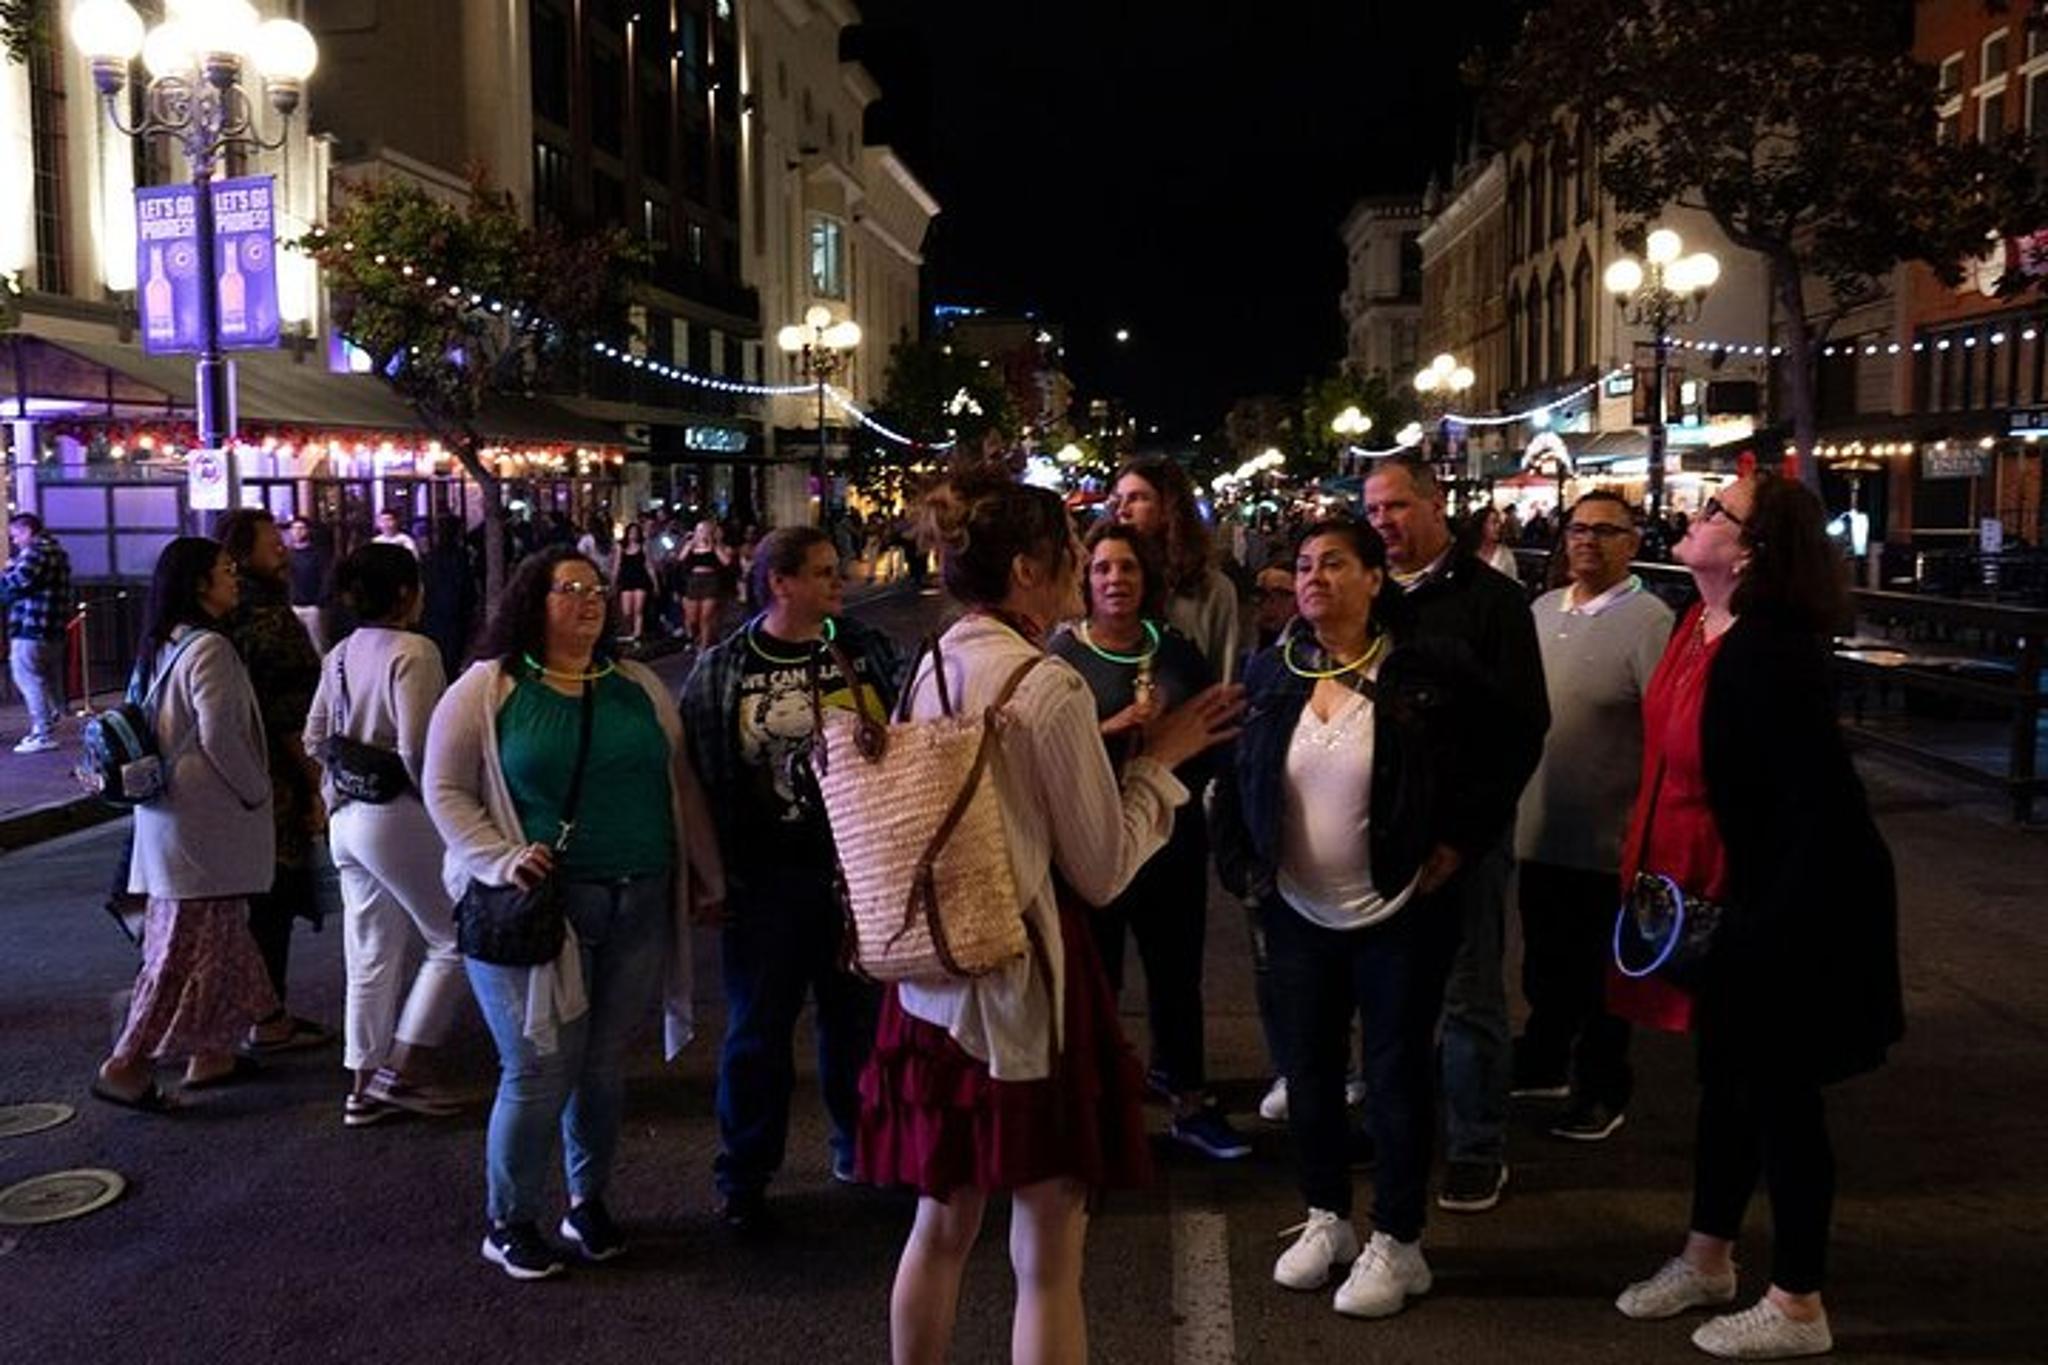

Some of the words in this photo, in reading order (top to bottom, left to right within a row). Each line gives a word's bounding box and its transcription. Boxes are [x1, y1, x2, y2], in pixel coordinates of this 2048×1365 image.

[139, 197, 174, 220] LET'S
[176, 195, 194, 215] GO
[216, 190, 248, 212] LET'S
[250, 187, 268, 209] GO
[742, 673, 766, 690] WE
[770, 667, 807, 684] CAN
